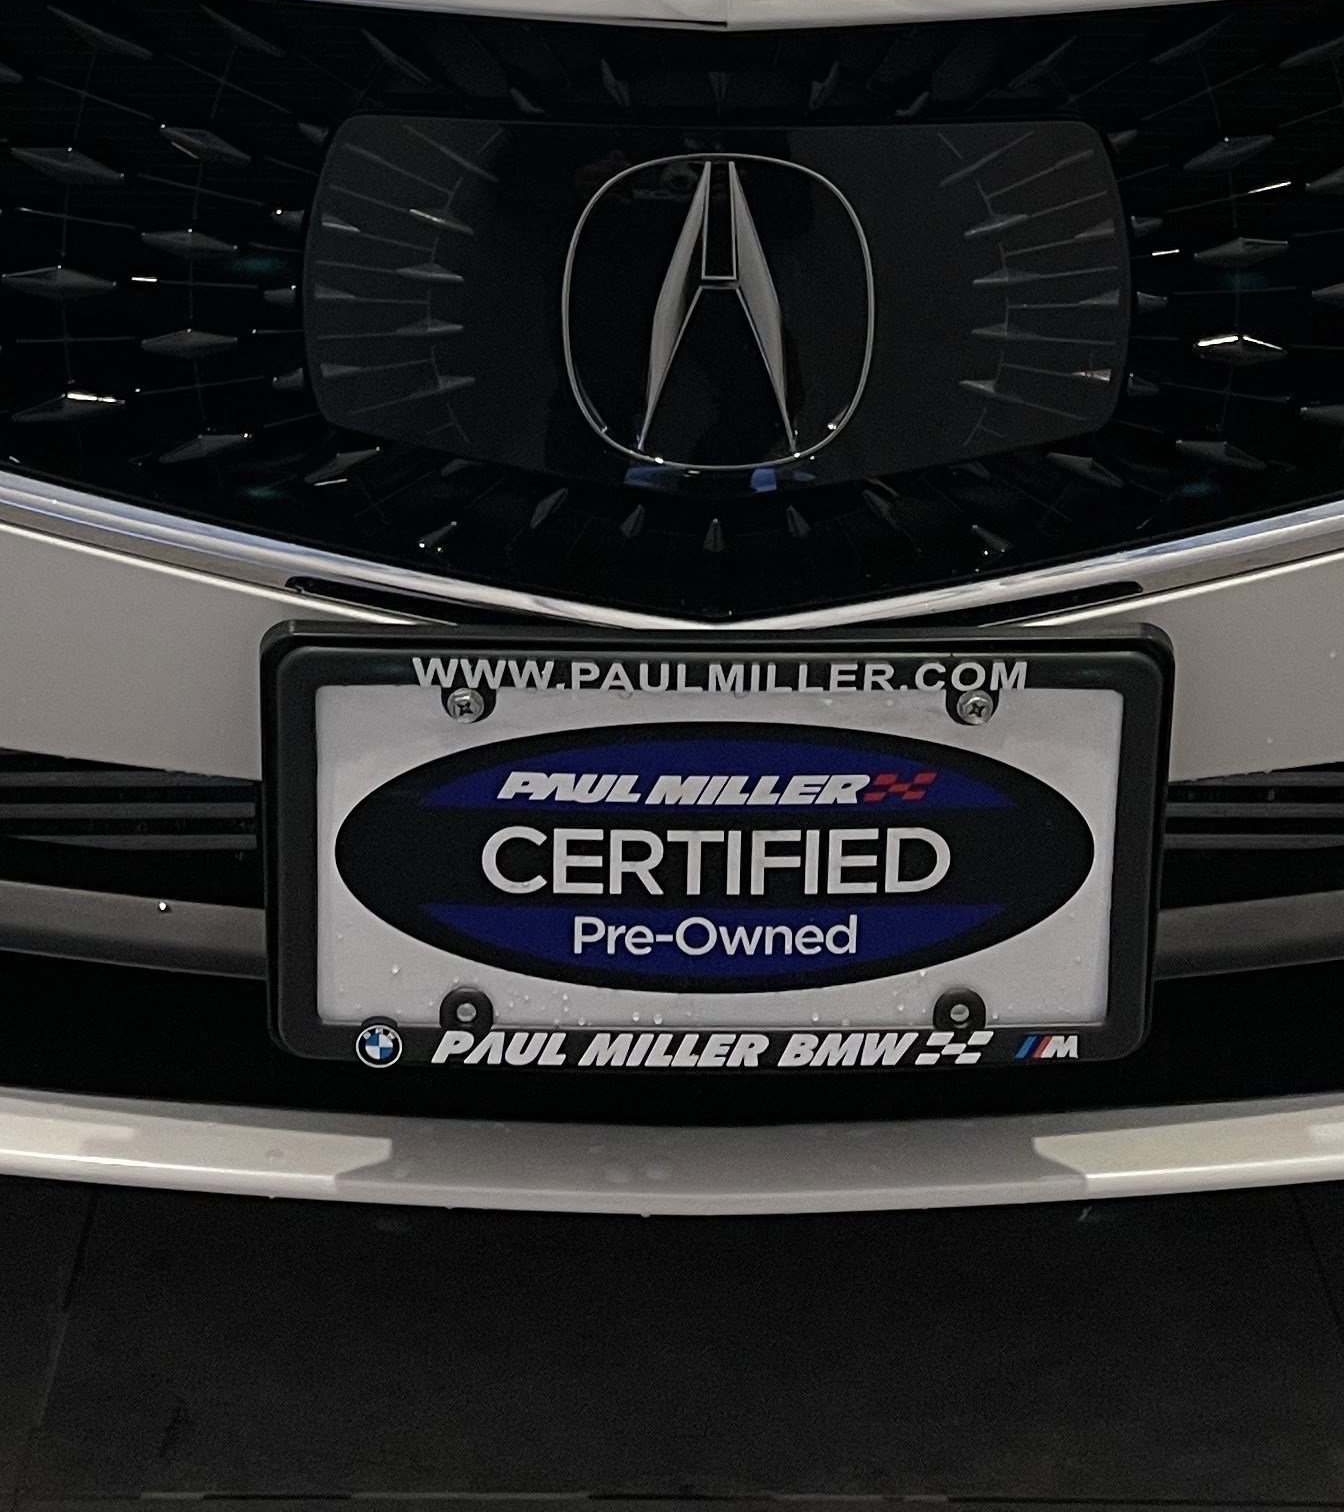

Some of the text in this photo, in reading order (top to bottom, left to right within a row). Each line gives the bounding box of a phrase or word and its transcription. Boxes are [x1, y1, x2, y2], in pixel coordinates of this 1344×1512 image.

[412, 656, 1028, 692] WWW.PAULMILLER.COM
[496, 771, 871, 805] PAUL MILLER
[481, 825, 952, 896] CERTIFIED
[572, 914, 858, 956] Pre-Owned
[430, 1030, 919, 1068] PAUL MILLER BMW
